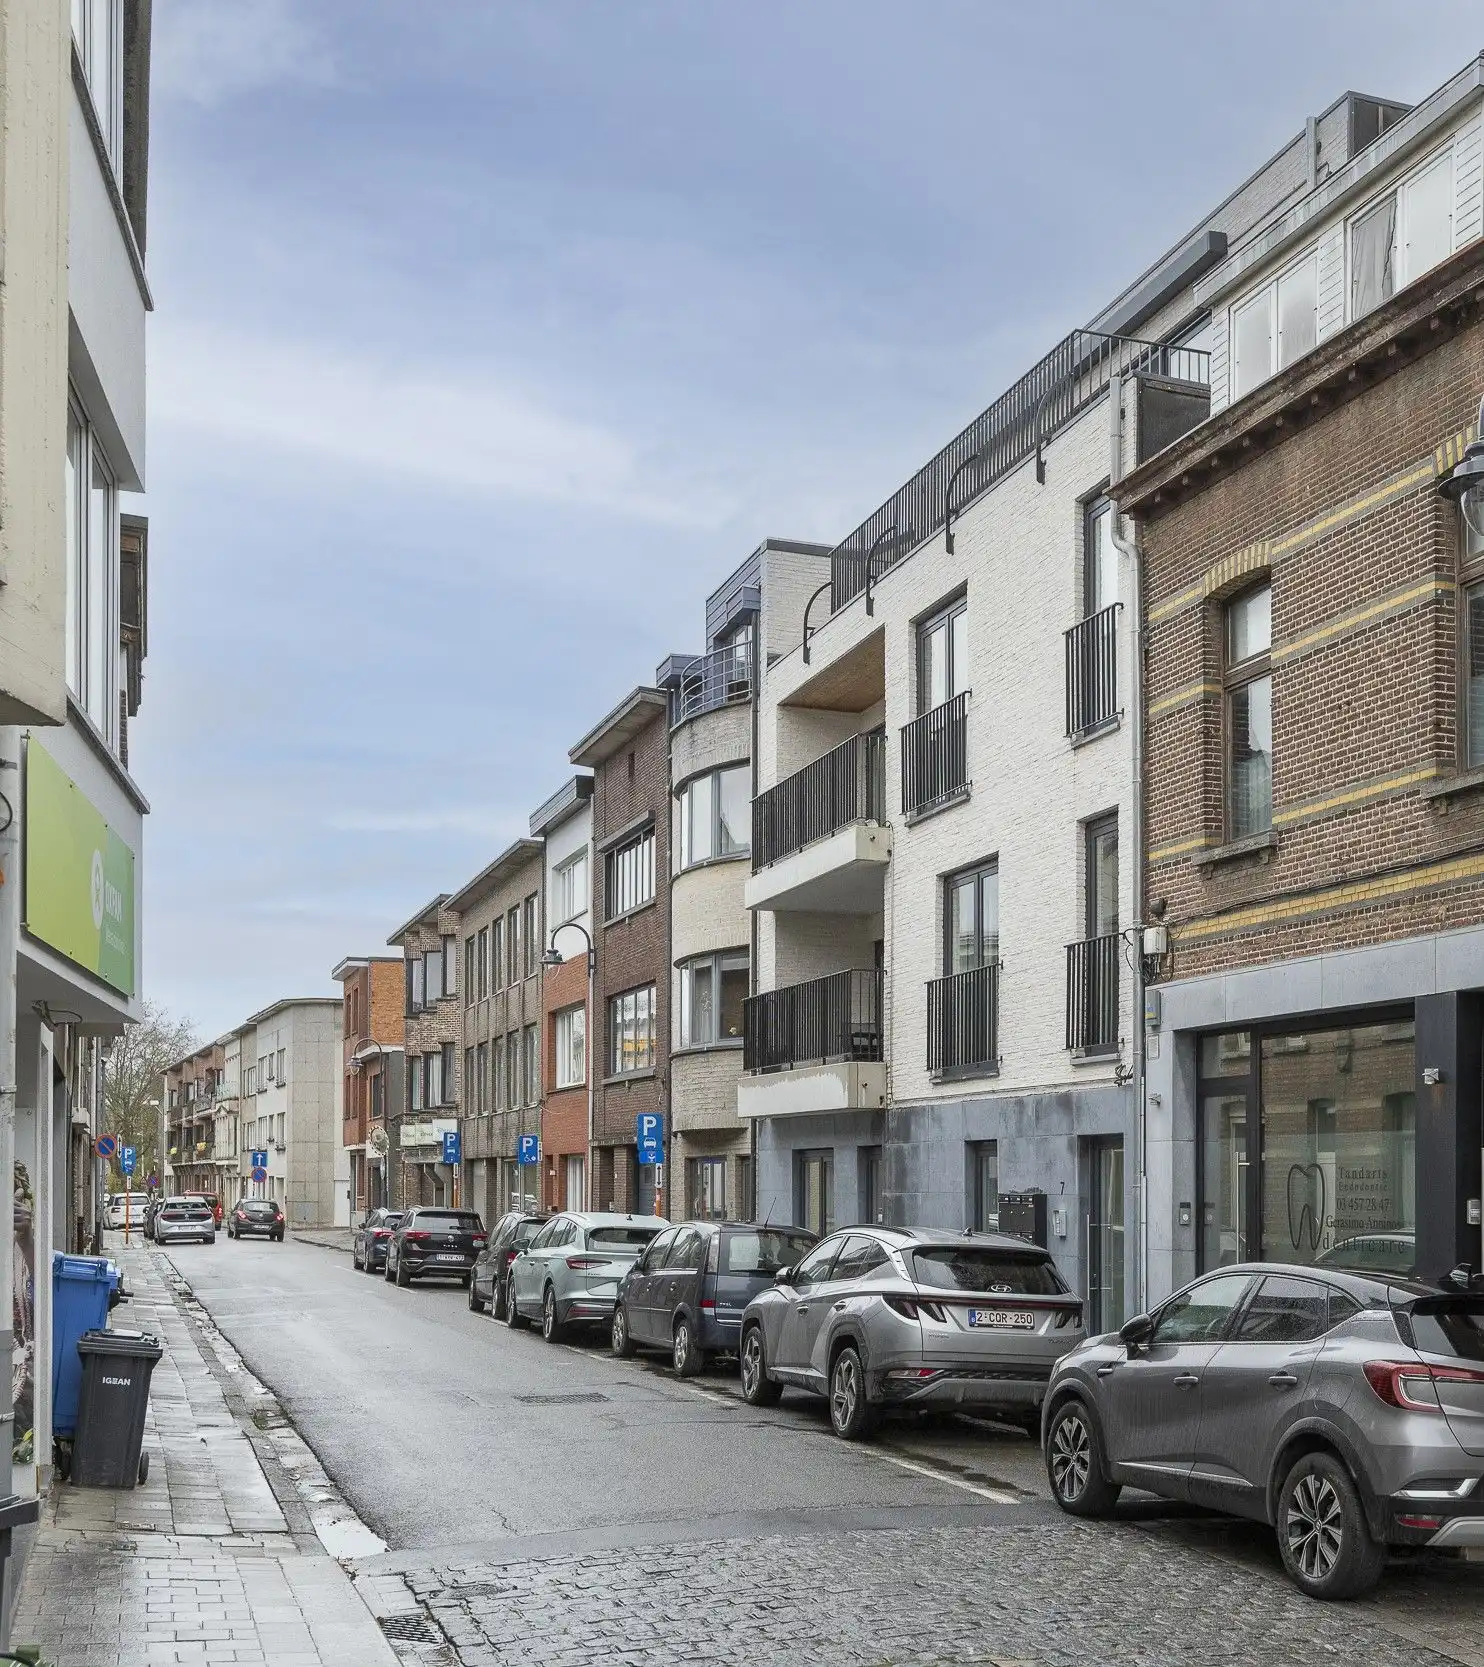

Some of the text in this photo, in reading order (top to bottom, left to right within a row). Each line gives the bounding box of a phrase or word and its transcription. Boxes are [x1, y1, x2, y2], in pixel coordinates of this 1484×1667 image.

[643, 1116, 657, 1136] P
[447, 1134, 456, 1147] P
[522, 1137, 534, 1153] P
[124, 1148, 133, 1159] P
[1060, 1181, 1065, 1195] 7
[102, 1376, 131, 1386] IGEAN
